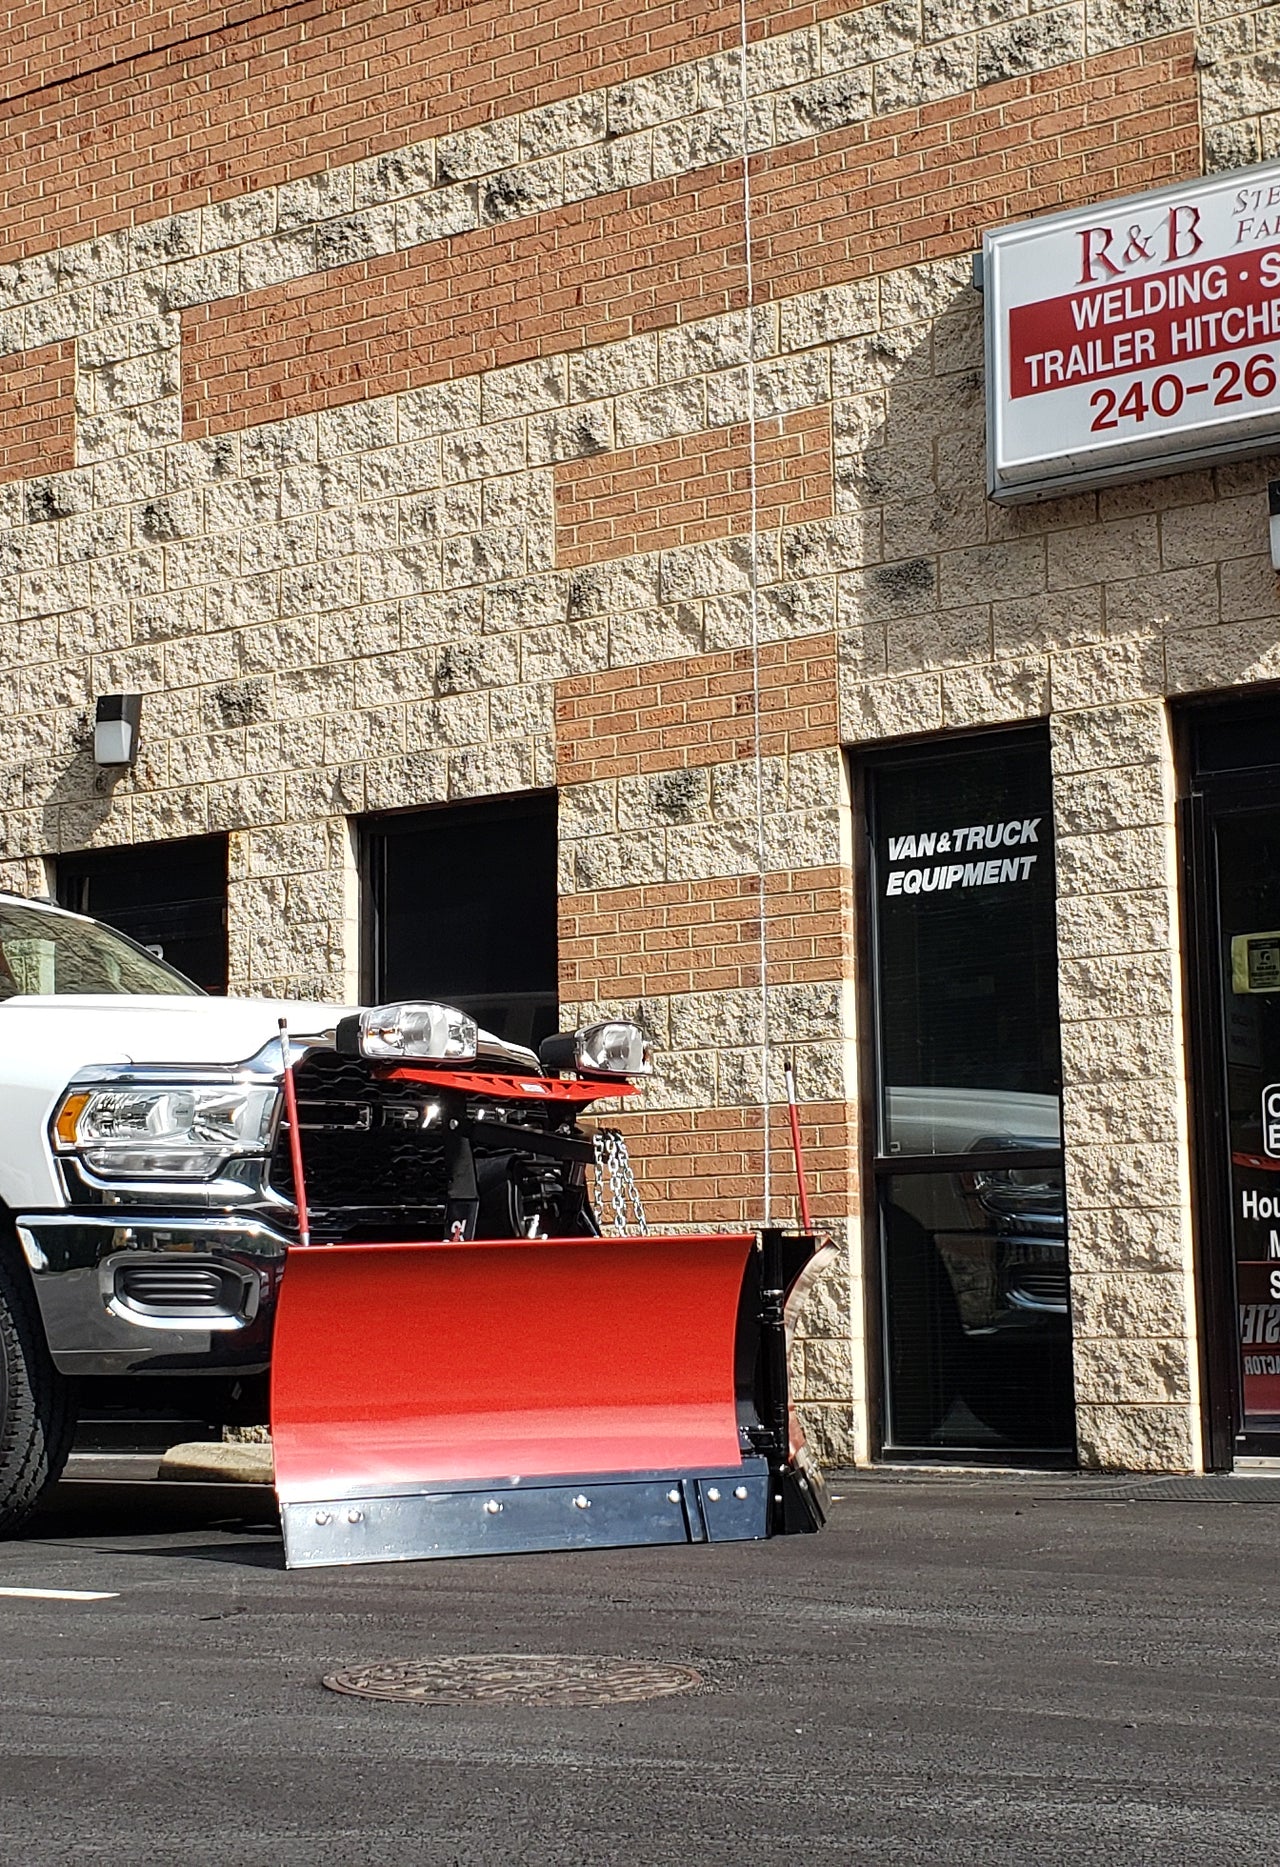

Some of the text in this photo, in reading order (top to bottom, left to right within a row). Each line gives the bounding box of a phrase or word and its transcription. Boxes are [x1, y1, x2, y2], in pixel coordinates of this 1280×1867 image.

[1074, 205, 1203, 286] R&B
[1071, 265, 1227, 331] WELDING
[1024, 328, 1156, 388] TRAILER
[888, 818, 1041, 861] VAN&TRUCK
[886, 855, 1037, 896] EQUIPMENT
